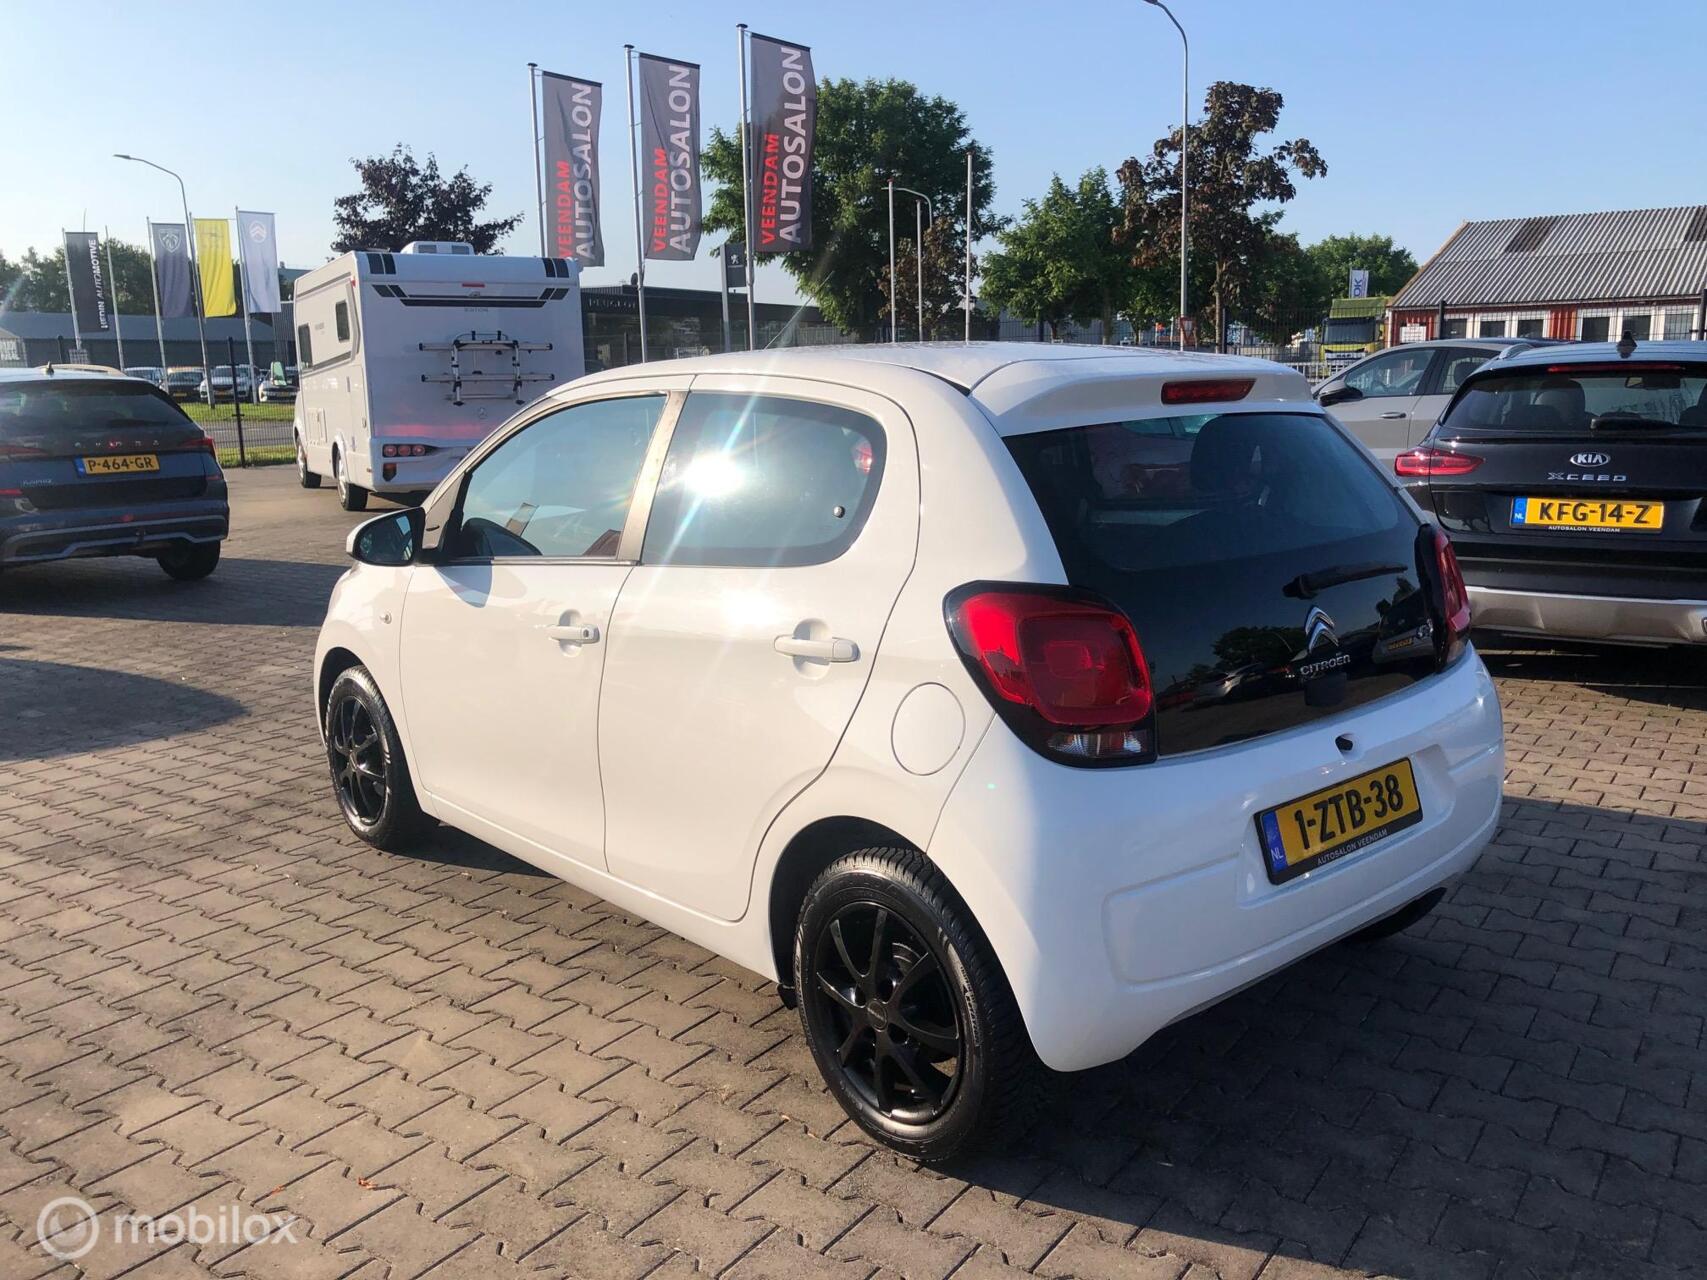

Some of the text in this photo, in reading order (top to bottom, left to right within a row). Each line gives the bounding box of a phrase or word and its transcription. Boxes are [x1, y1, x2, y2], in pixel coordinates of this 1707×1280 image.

[571, 83, 596, 259] AUTOSALON
[668, 65, 691, 254] AUTOSALON
[779, 47, 806, 244] AUTOSALON
[555, 160, 573, 258] VEENDAM
[653, 148, 669, 252] VEENDAM
[760, 133, 779, 245] VEENDAM
[88, 239, 109, 329] HEDIN AUTOMOTIVE
[87, 457, 154, 472] P-464-GR
[1547, 472, 1627, 482] XCEED
[1577, 453, 1603, 464] KIA
[1514, 512, 1525, 520] NL
[1539, 502, 1653, 524] KFG-14-Z
[1294, 774, 1404, 850] 1-ZTB-38
[1317, 828, 1388, 866] AUTOSALON VEENDAM
[1270, 847, 1284, 862] NL
